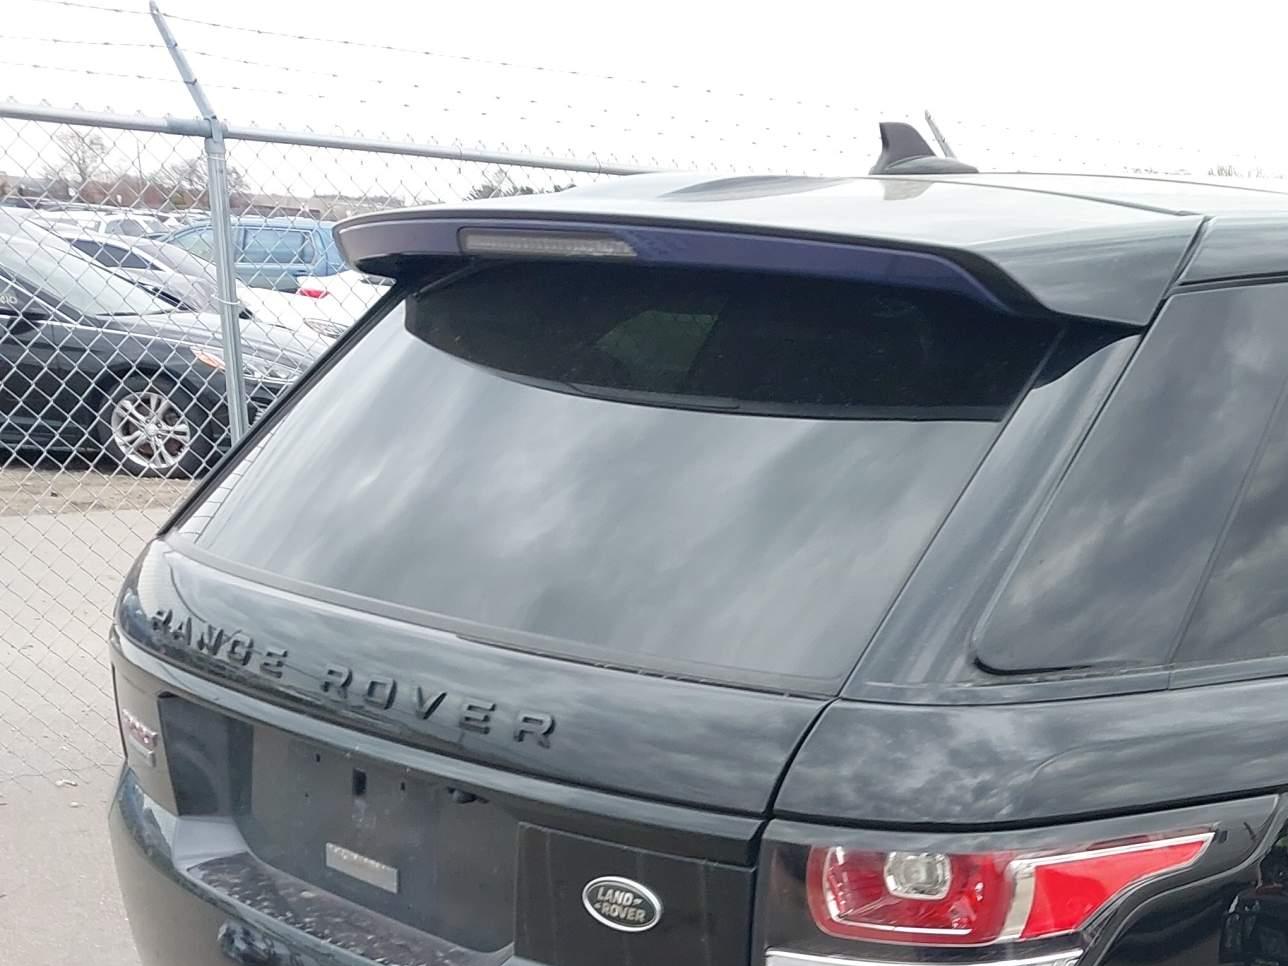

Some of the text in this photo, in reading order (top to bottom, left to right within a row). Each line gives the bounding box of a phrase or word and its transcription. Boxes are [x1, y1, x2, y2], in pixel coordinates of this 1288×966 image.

[151, 608, 556, 749] RANGE ROVER
[597, 887, 634, 906] LAND
[601, 902, 646, 922] ROVER
